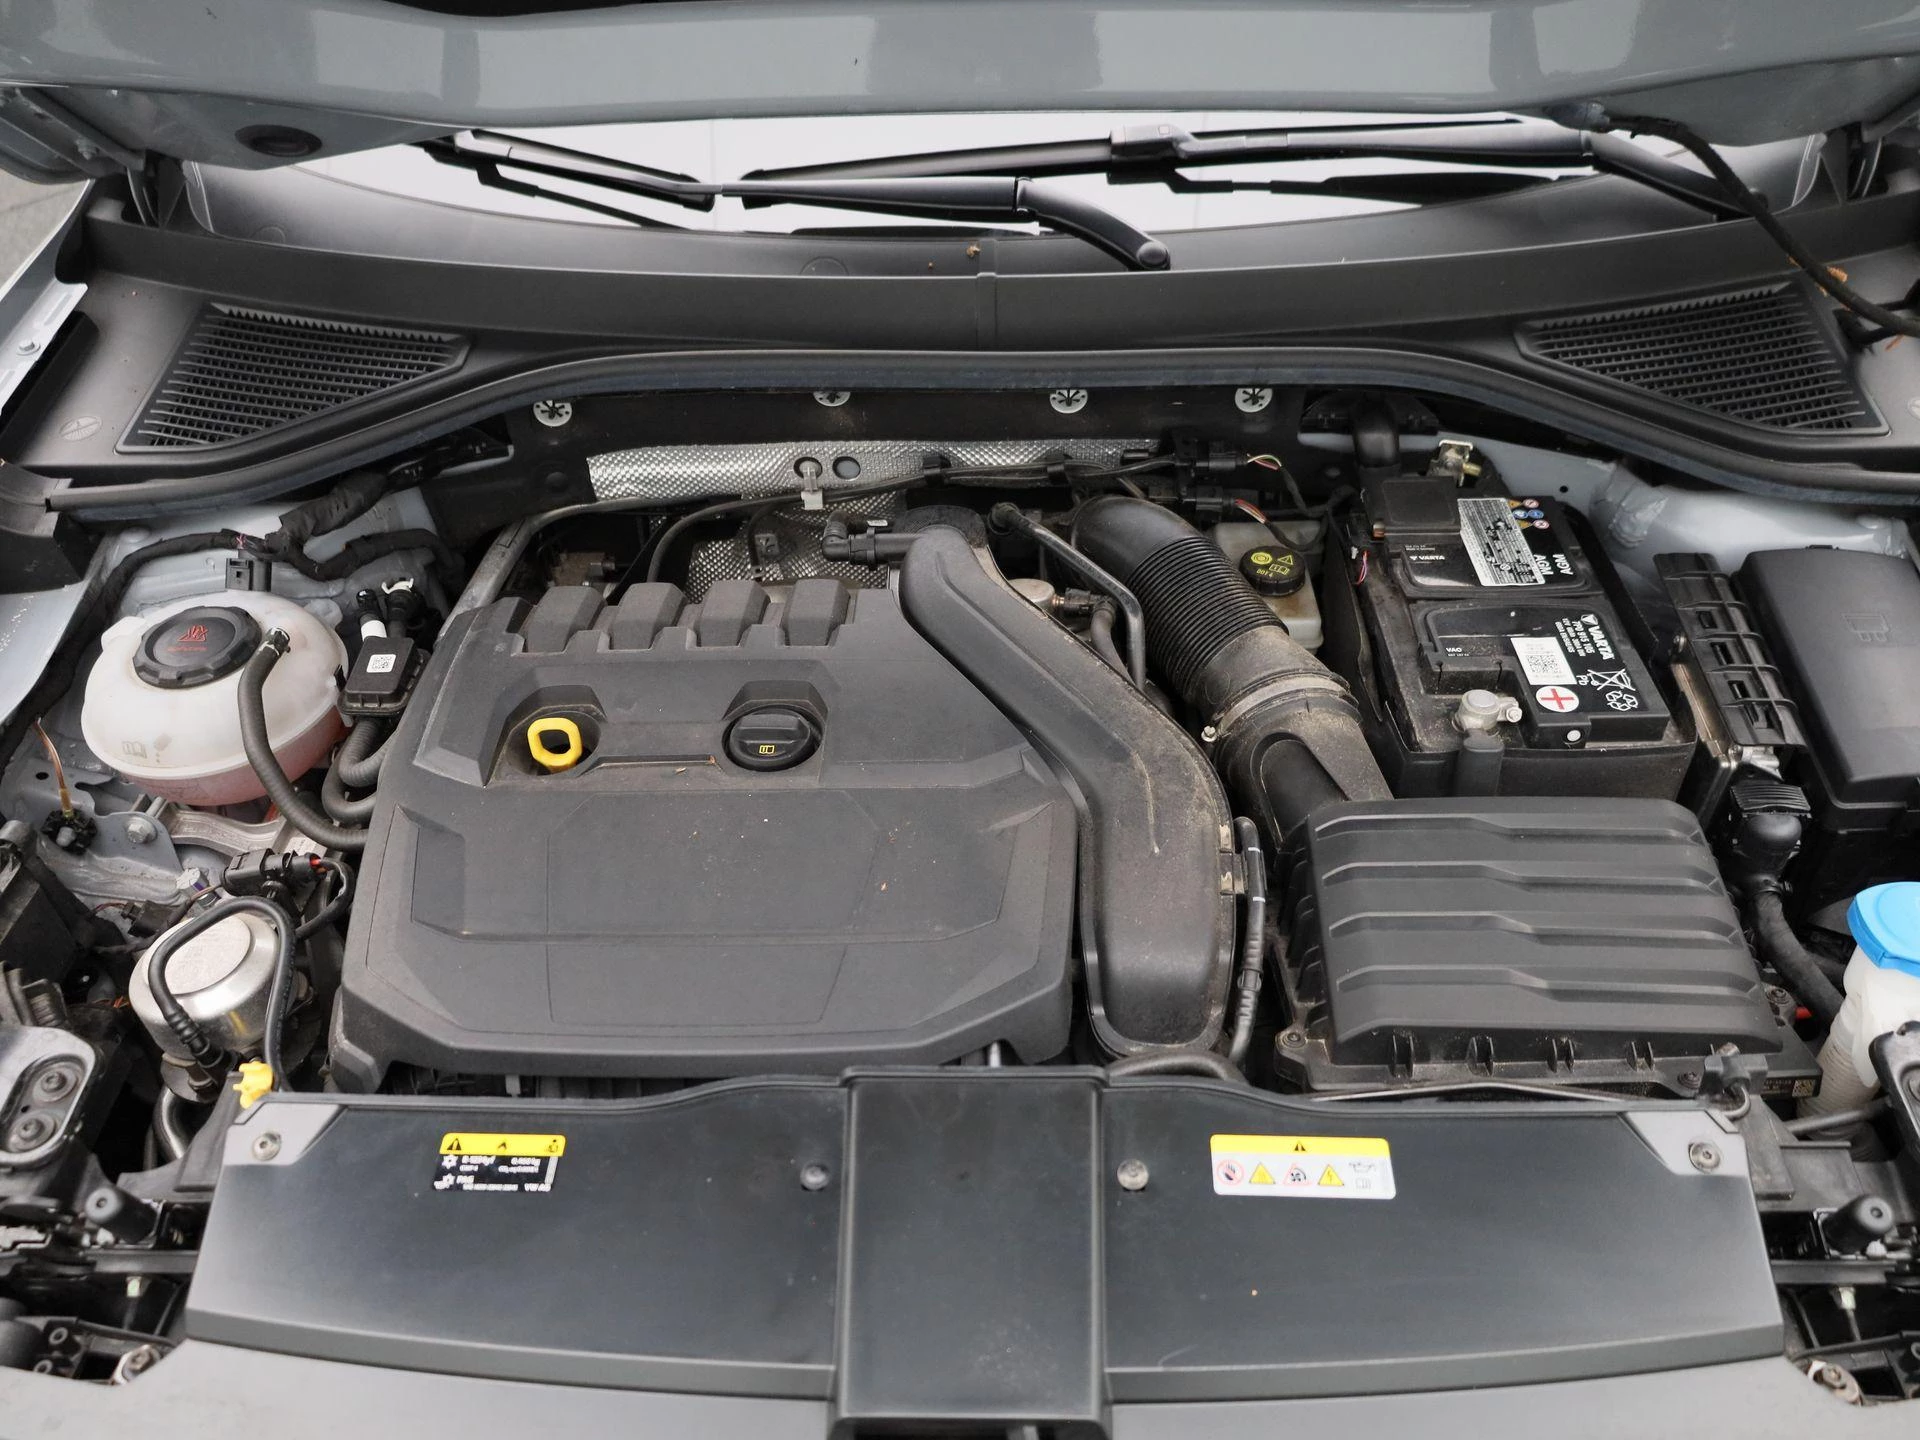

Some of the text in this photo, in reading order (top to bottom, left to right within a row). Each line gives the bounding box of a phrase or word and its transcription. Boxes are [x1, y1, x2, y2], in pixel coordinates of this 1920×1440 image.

[1533, 554, 1554, 575] AGM
[1552, 553, 1574, 575] AGM
[1588, 625, 1615, 660] VARTA
[1576, 674, 1590, 686] Pb
